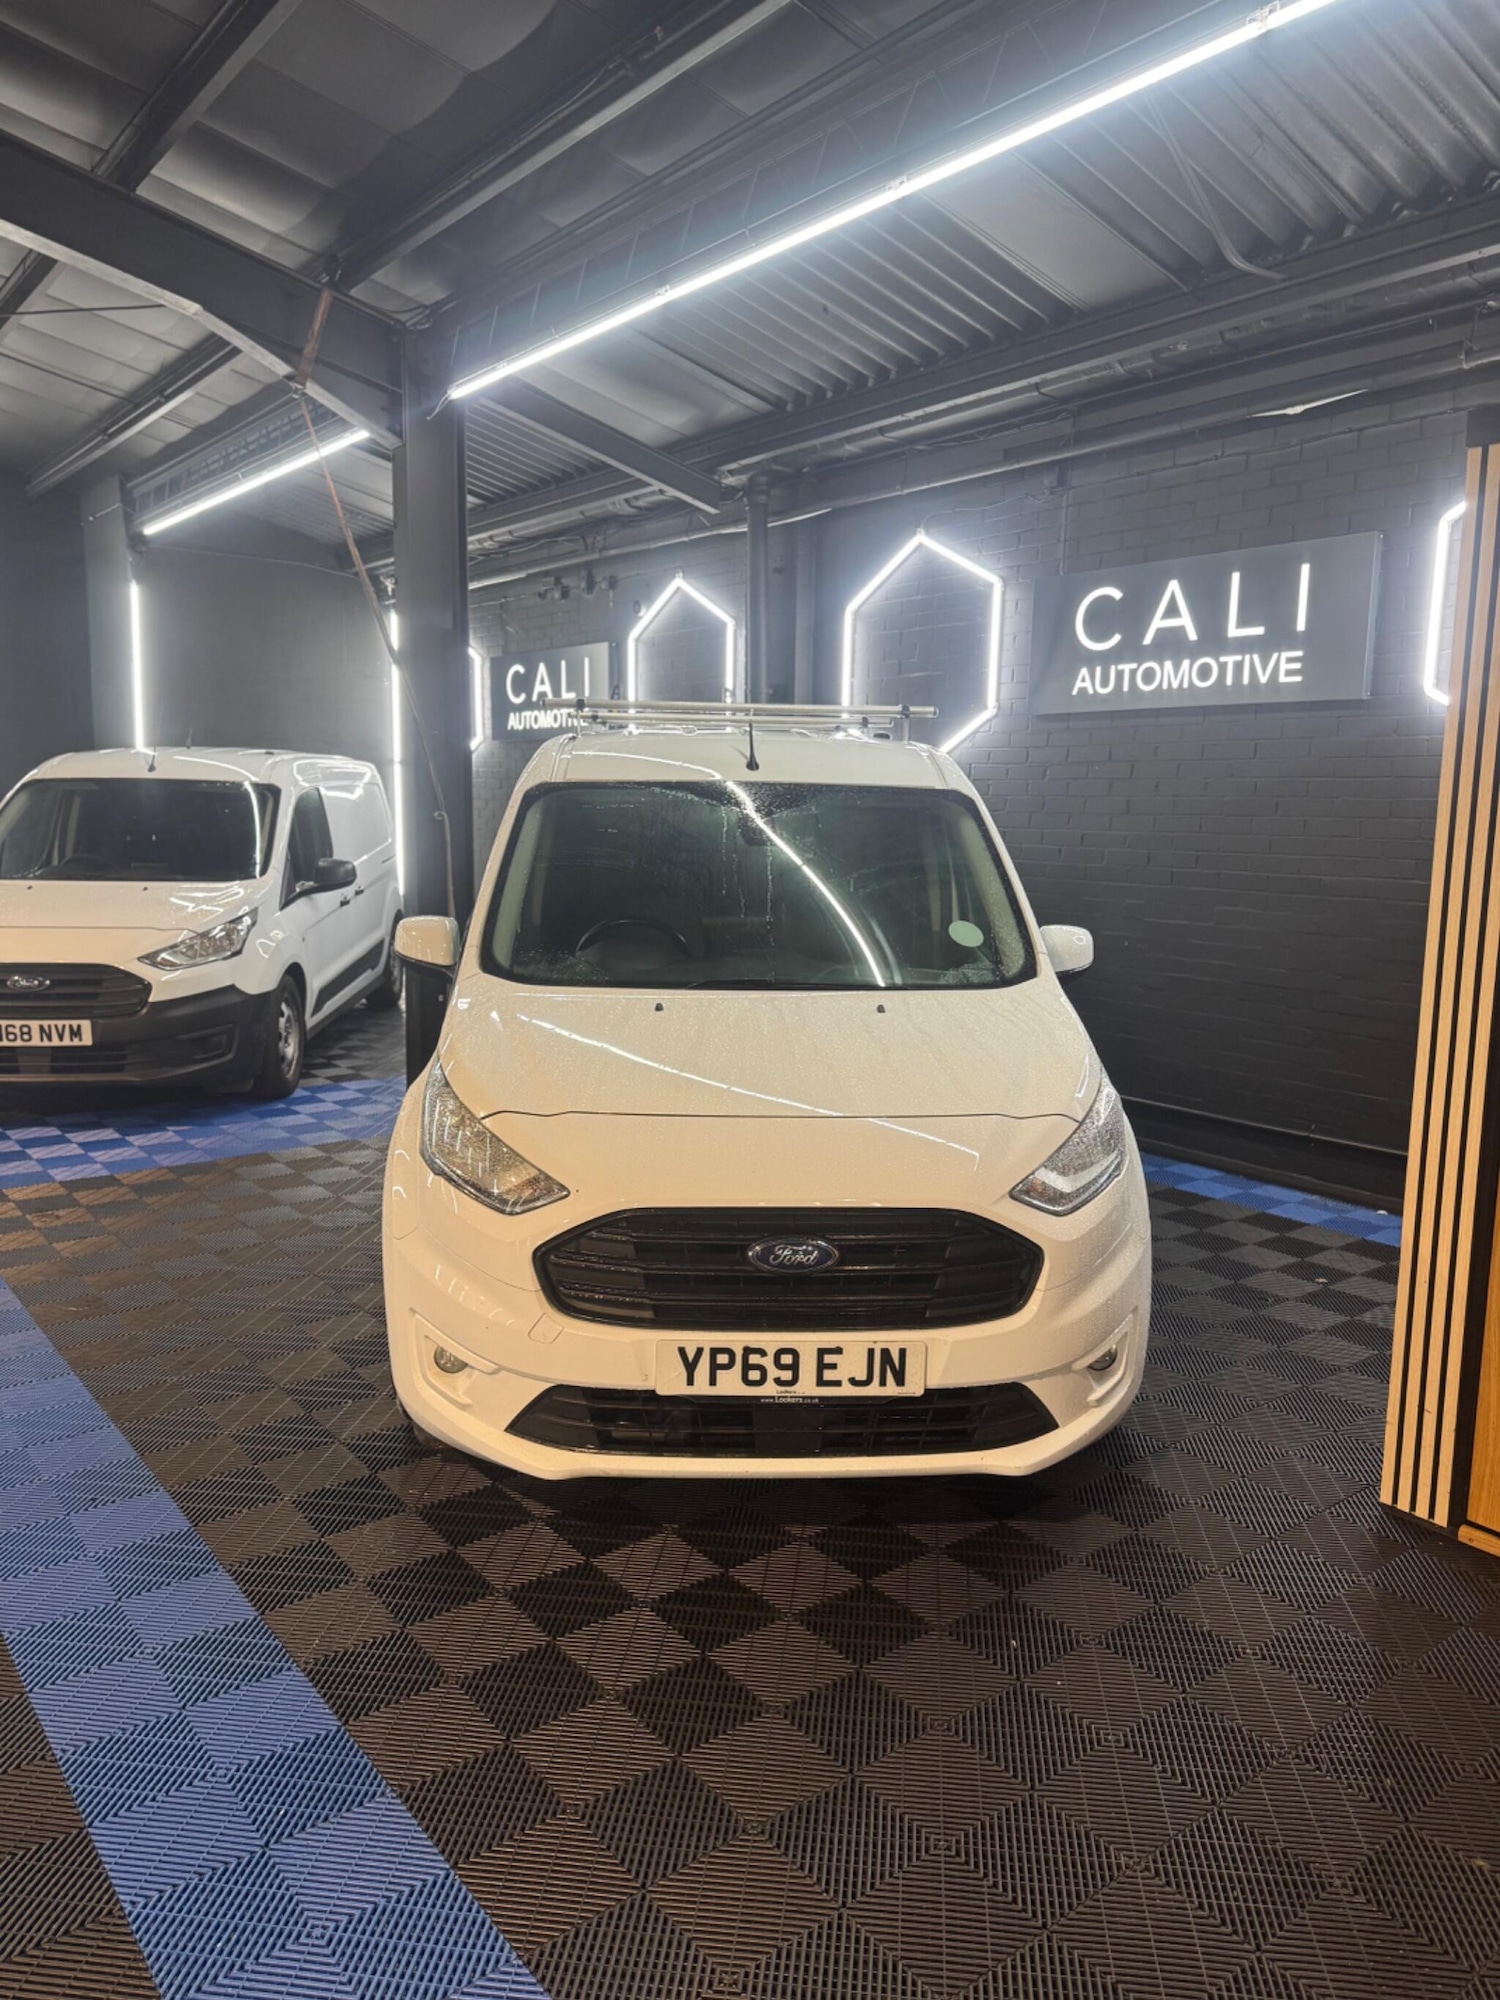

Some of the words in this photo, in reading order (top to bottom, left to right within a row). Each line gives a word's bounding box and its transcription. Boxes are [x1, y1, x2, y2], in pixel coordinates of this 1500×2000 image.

[1075, 563, 1310, 650] CALI
[506, 656, 590, 704] CALI
[1072, 651, 1304, 695] AUTOMOTIVE
[0, 1024, 32, 1042] 68
[39, 1024, 83, 1042] NVM
[769, 1244, 818, 1266] Ford
[677, 1346, 800, 1387] YP69
[816, 1346, 907, 1387] EJN
